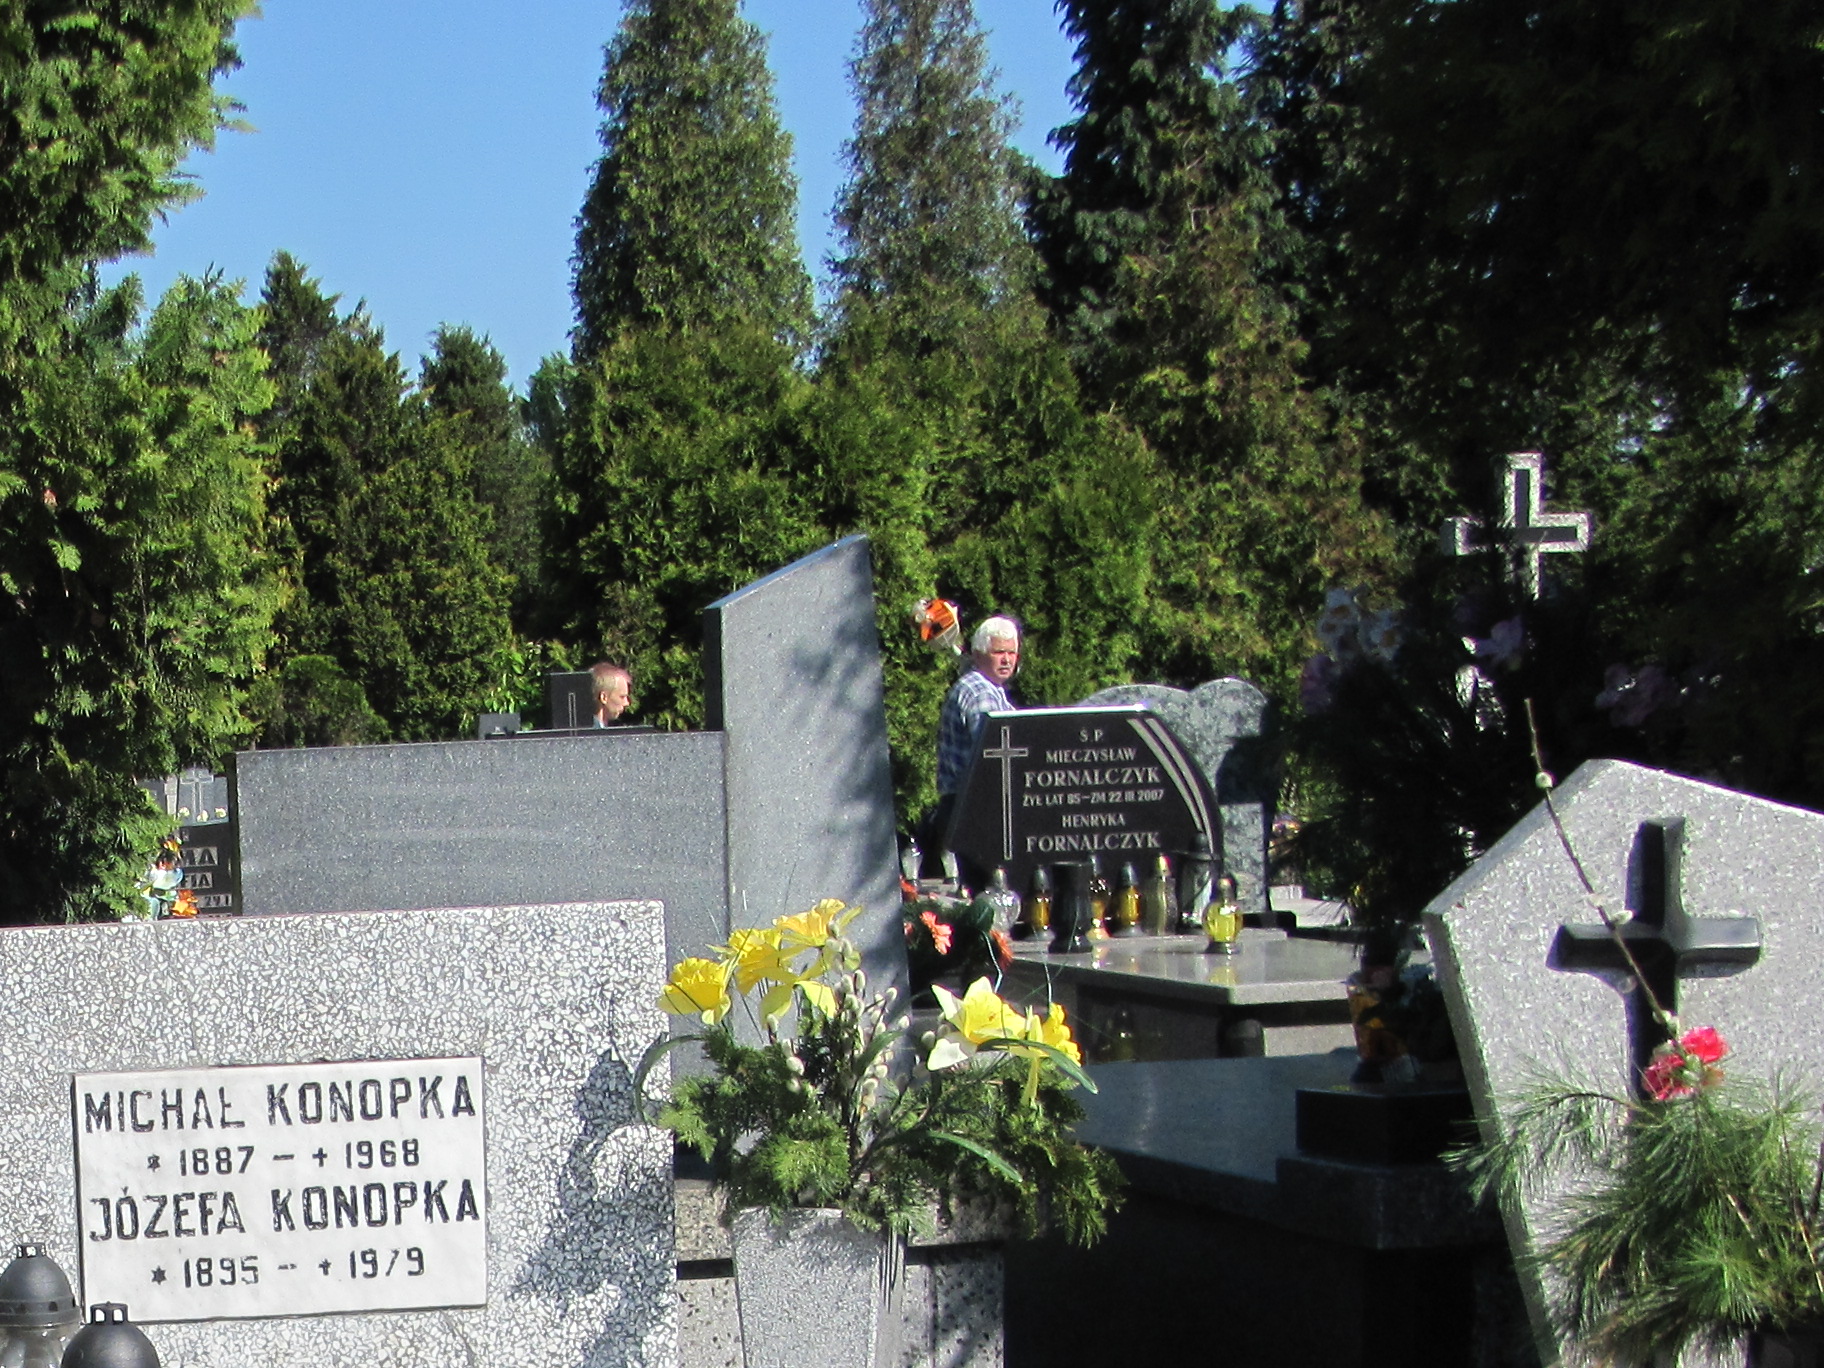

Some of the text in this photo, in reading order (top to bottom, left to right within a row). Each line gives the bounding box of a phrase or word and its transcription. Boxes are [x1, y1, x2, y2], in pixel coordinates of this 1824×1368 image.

[1045, 747, 1136, 763] MIECZYSŁAW
[1024, 767, 1160, 788] FORNALCZYK
[1045, 793, 1064, 806] LAT
[1137, 788, 1164, 802] 2007
[1061, 813, 1126, 828] HENRYKA
[1026, 831, 1161, 853] FORNALCZYK
[84, 1075, 476, 1133] MICHAŁ KONOPKA
[179, 1146, 255, 1176] 1887
[345, 1139, 421, 1169] 1968
[89, 1179, 480, 1242] JÓZEFA KONOPKA
[183, 1256, 260, 1288] 1895
